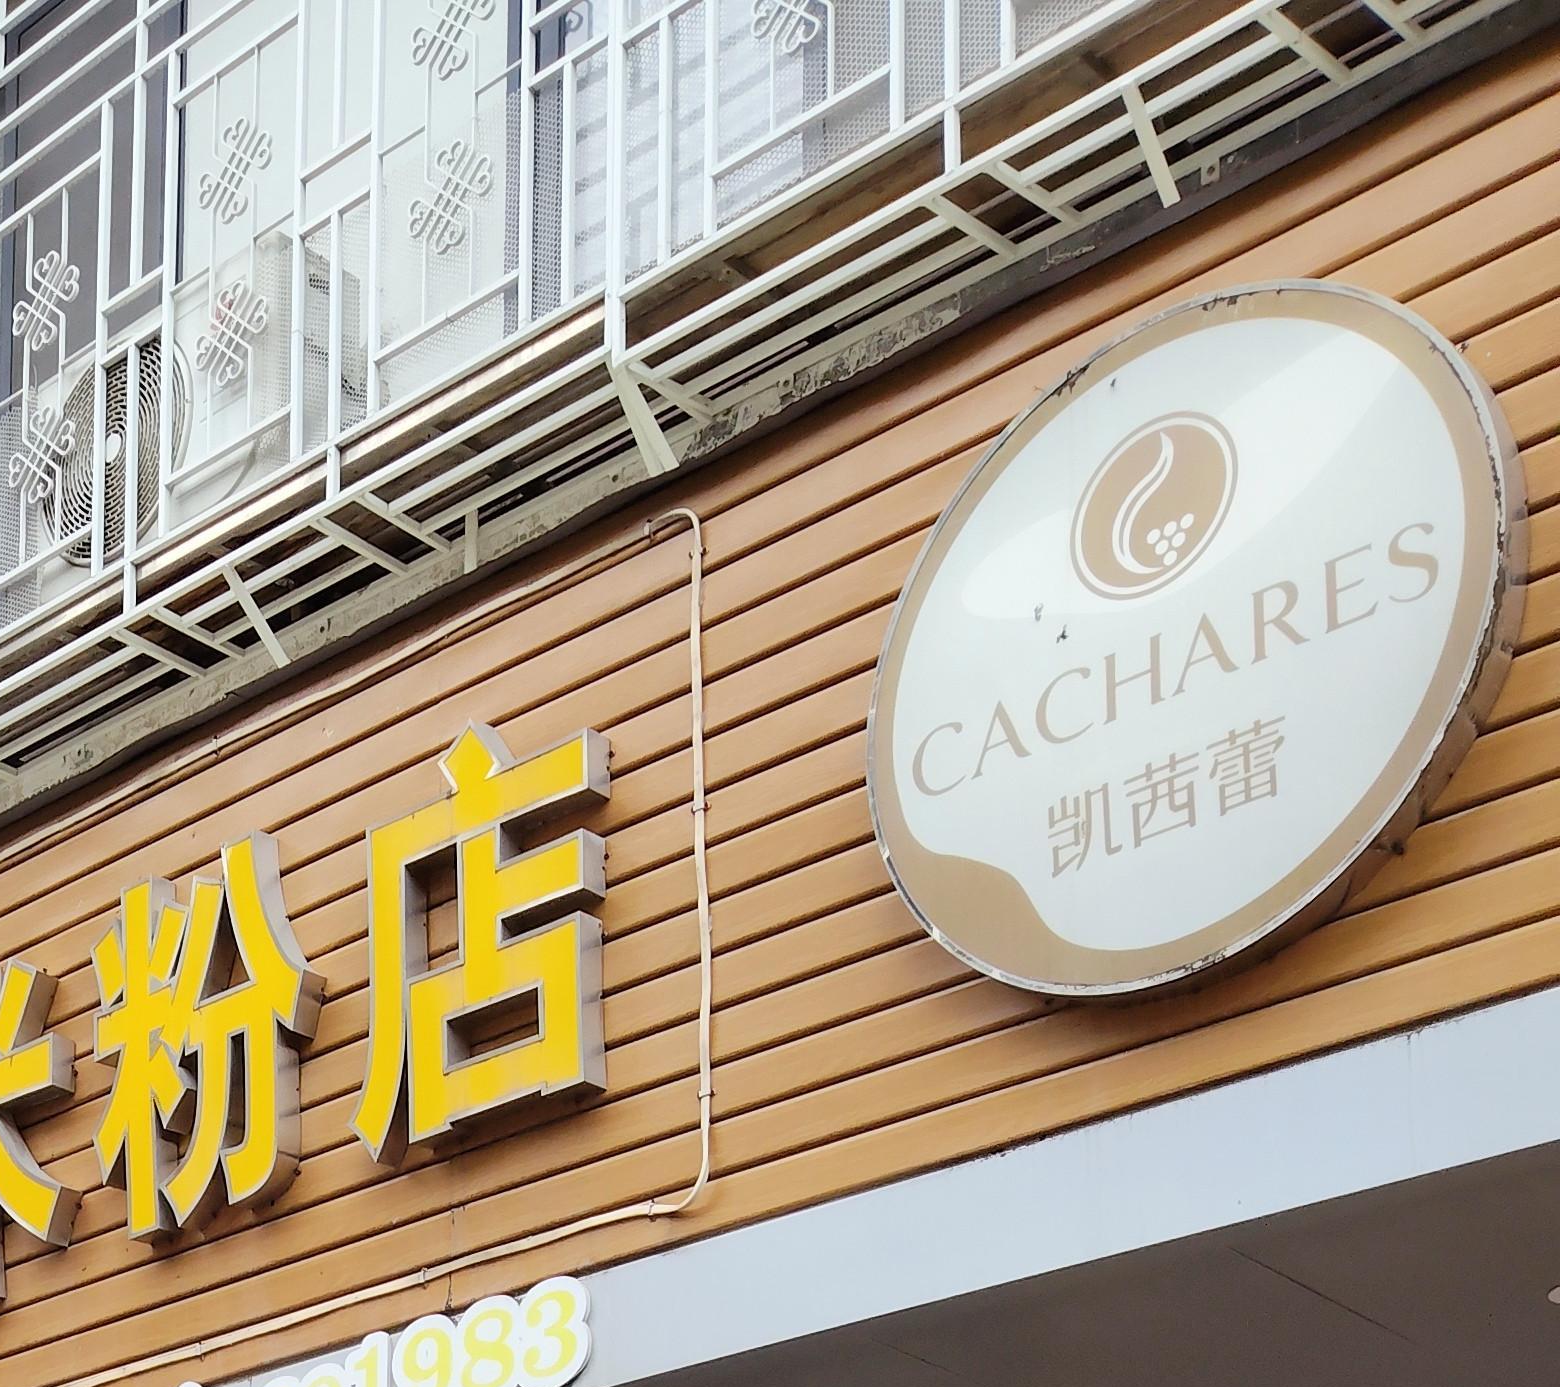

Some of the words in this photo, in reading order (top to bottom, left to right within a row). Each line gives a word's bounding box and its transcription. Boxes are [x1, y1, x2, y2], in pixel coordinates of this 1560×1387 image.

[910, 521, 1440, 797] CACHARES
[1045, 714, 1287, 879] 凯茜蕾
